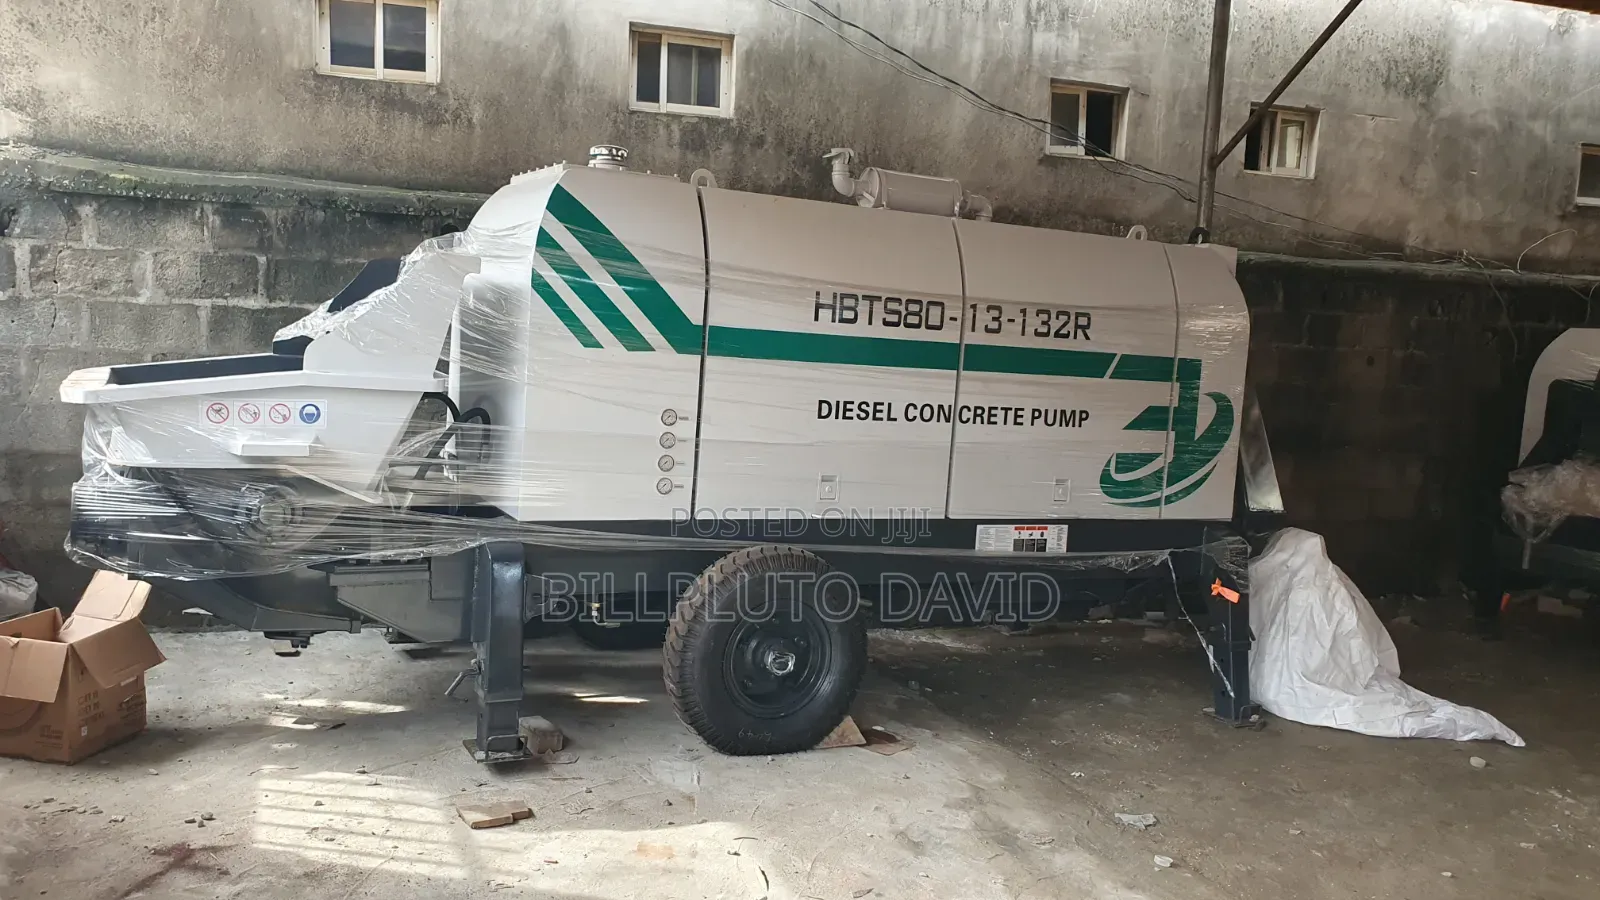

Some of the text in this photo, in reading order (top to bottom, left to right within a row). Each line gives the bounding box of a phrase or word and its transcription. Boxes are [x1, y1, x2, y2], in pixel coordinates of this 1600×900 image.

[814, 291, 1092, 340] HBTS80-13-132R
[817, 399, 1090, 428] DIESEL CONCRETE PUMP
